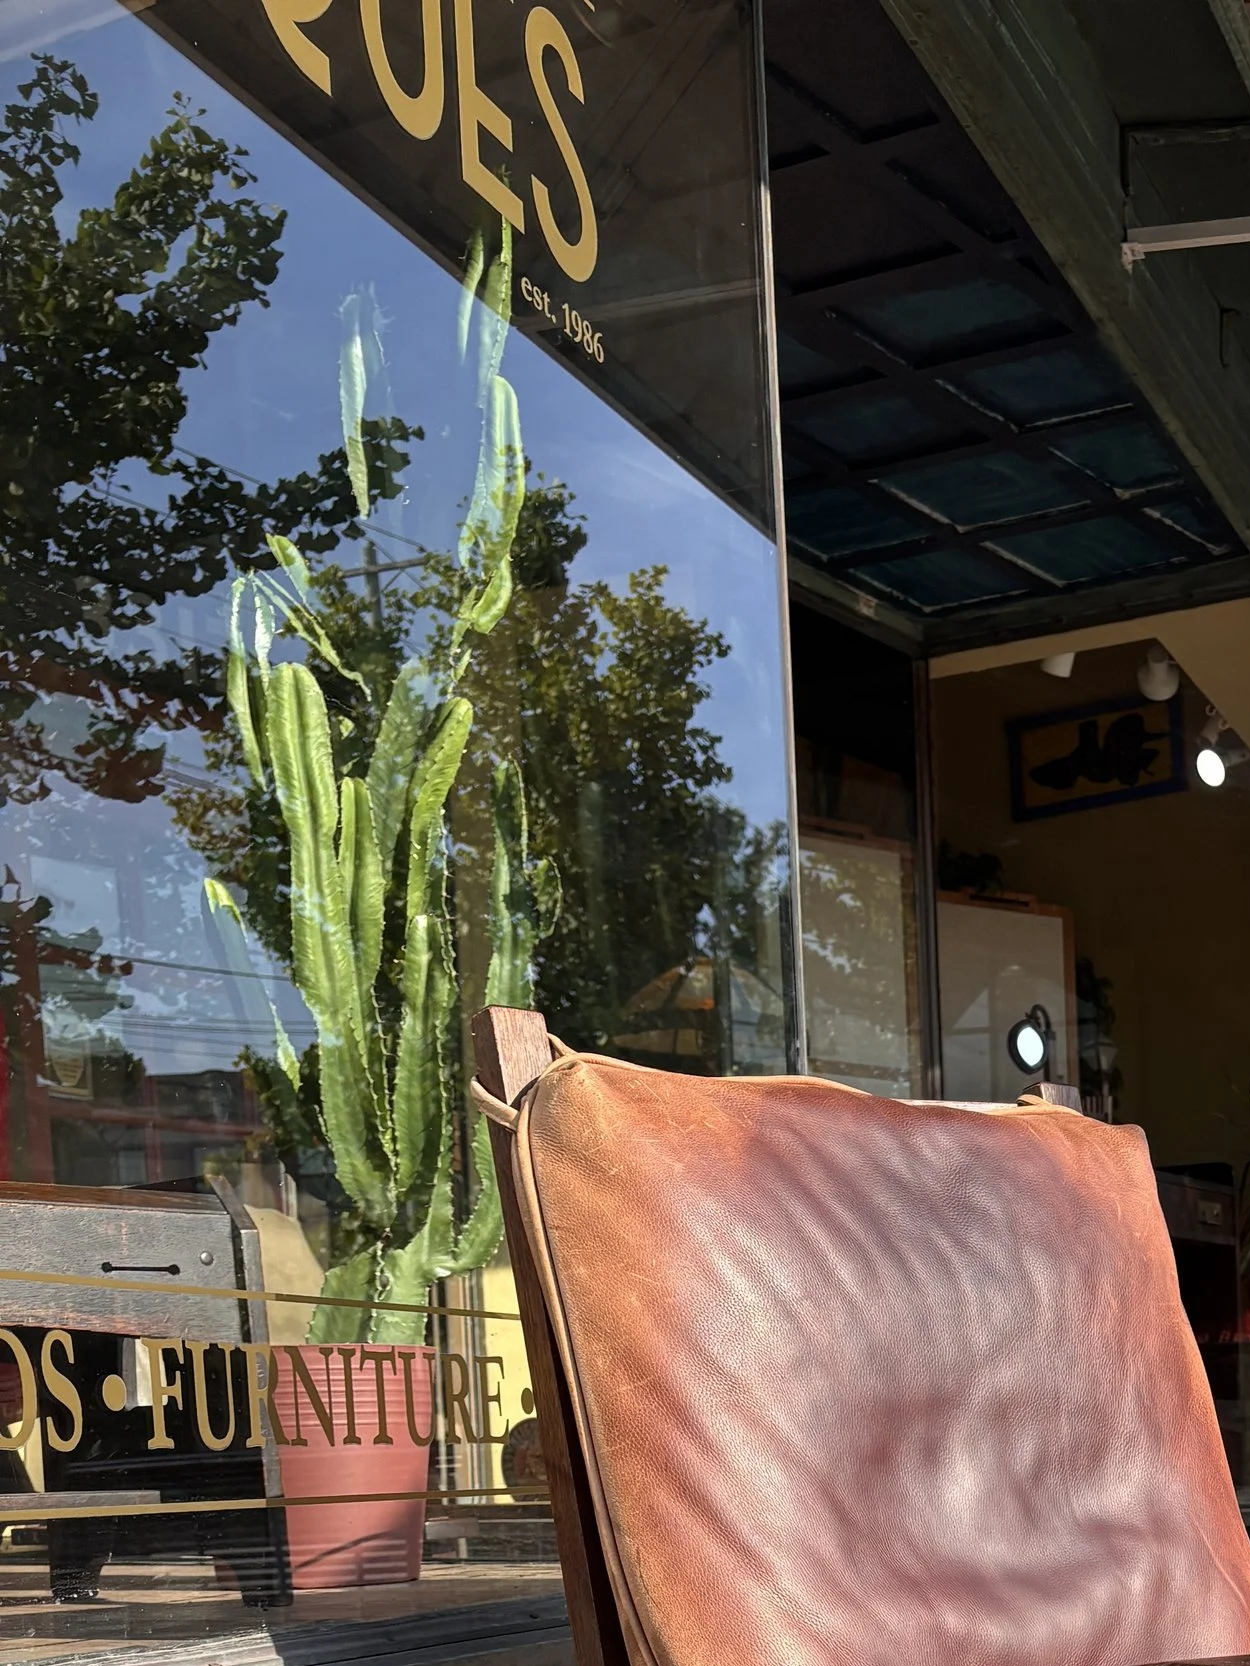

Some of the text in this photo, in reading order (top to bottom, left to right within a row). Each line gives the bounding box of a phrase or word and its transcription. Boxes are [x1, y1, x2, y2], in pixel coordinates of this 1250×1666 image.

[521, 276, 604, 363] est. 1986
[141, 1337, 510, 1451] FURNITURE
